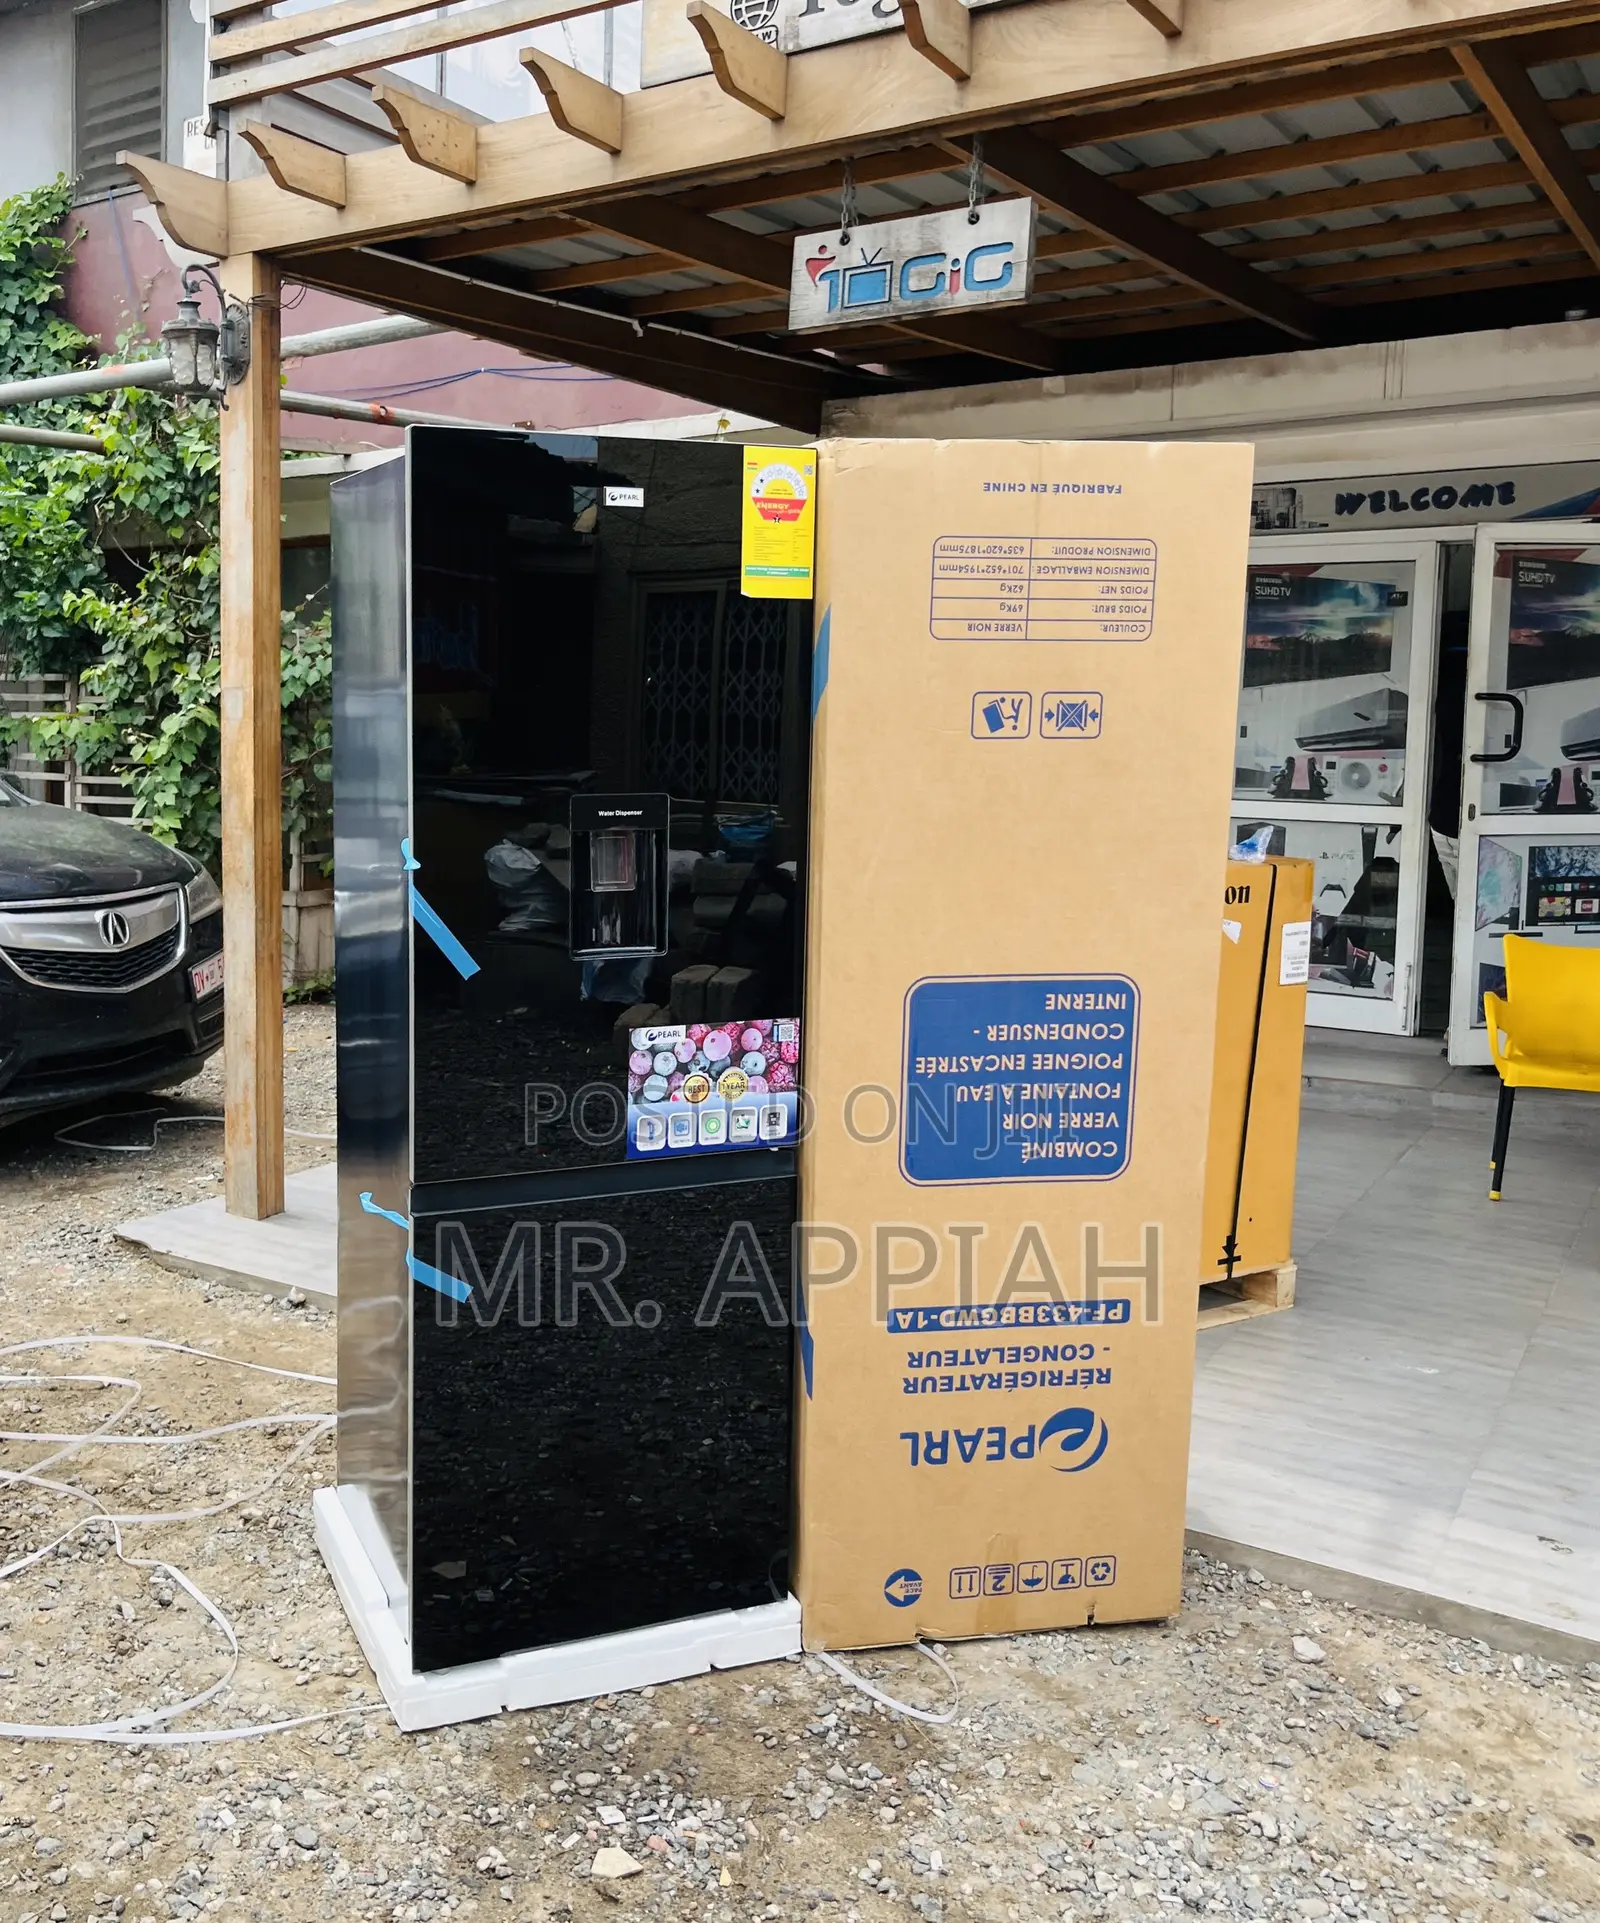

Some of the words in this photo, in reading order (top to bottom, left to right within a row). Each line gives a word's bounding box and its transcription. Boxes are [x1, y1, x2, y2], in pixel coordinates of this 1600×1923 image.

[983, 482, 1026, 492] CHINE
[1030, 483, 1048, 492] EN
[1052, 484, 1122, 495] FABRIQUÉ
[619, 493, 640, 501] PEARL
[1334, 481, 1516, 517] WELCOME
[1052, 546, 1094, 556] PRODUIT:
[1096, 546, 1151, 556] DIMENSION
[1096, 566, 1150, 576] DIMENSION
[1000, 582, 1024, 593] 62Kg
[1098, 586, 1118, 594] NET:
[1120, 586, 1149, 594] POIDS
[999, 602, 1024, 612] 69Kg
[1092, 604, 1116, 613] BRUT:
[1118, 604, 1148, 614] POIDS
[967, 622, 992, 632] NOIR
[994, 623, 1023, 632] VERRE
[1100, 624, 1146, 633] COULEUR:
[1045, 993, 1127, 1010] INTERNE
[657, 1030, 681, 1039] PEARL
[987, 1022, 1125, 1042] CONDENSUER
[915, 1054, 1026, 1078] ENCASTRÉE
[1032, 1052, 1124, 1070] POIGNEE
[688, 1084, 706, 1094] BEST
[726, 1081, 746, 1090] YEAR
[1020, 1082, 1121, 1100] FONTAINE
[956, 1084, 993, 1102] EAU
[1001, 1084, 1016, 1105] À
[1002, 1112, 1052, 1130] NOIR
[1058, 1112, 1120, 1128] VERRE
[1021, 1141, 1118, 1164] COMBINÉ
[895, 1302, 1124, 1330] PF-433BBGWD-1A
[907, 1343, 1095, 1368] CONGELATEUR
[903, 1368, 1112, 1394] RÉFRIGÉRATEUR
[900, 1424, 1036, 1467] PEARL
[992, 1575, 1006, 1592] 2
